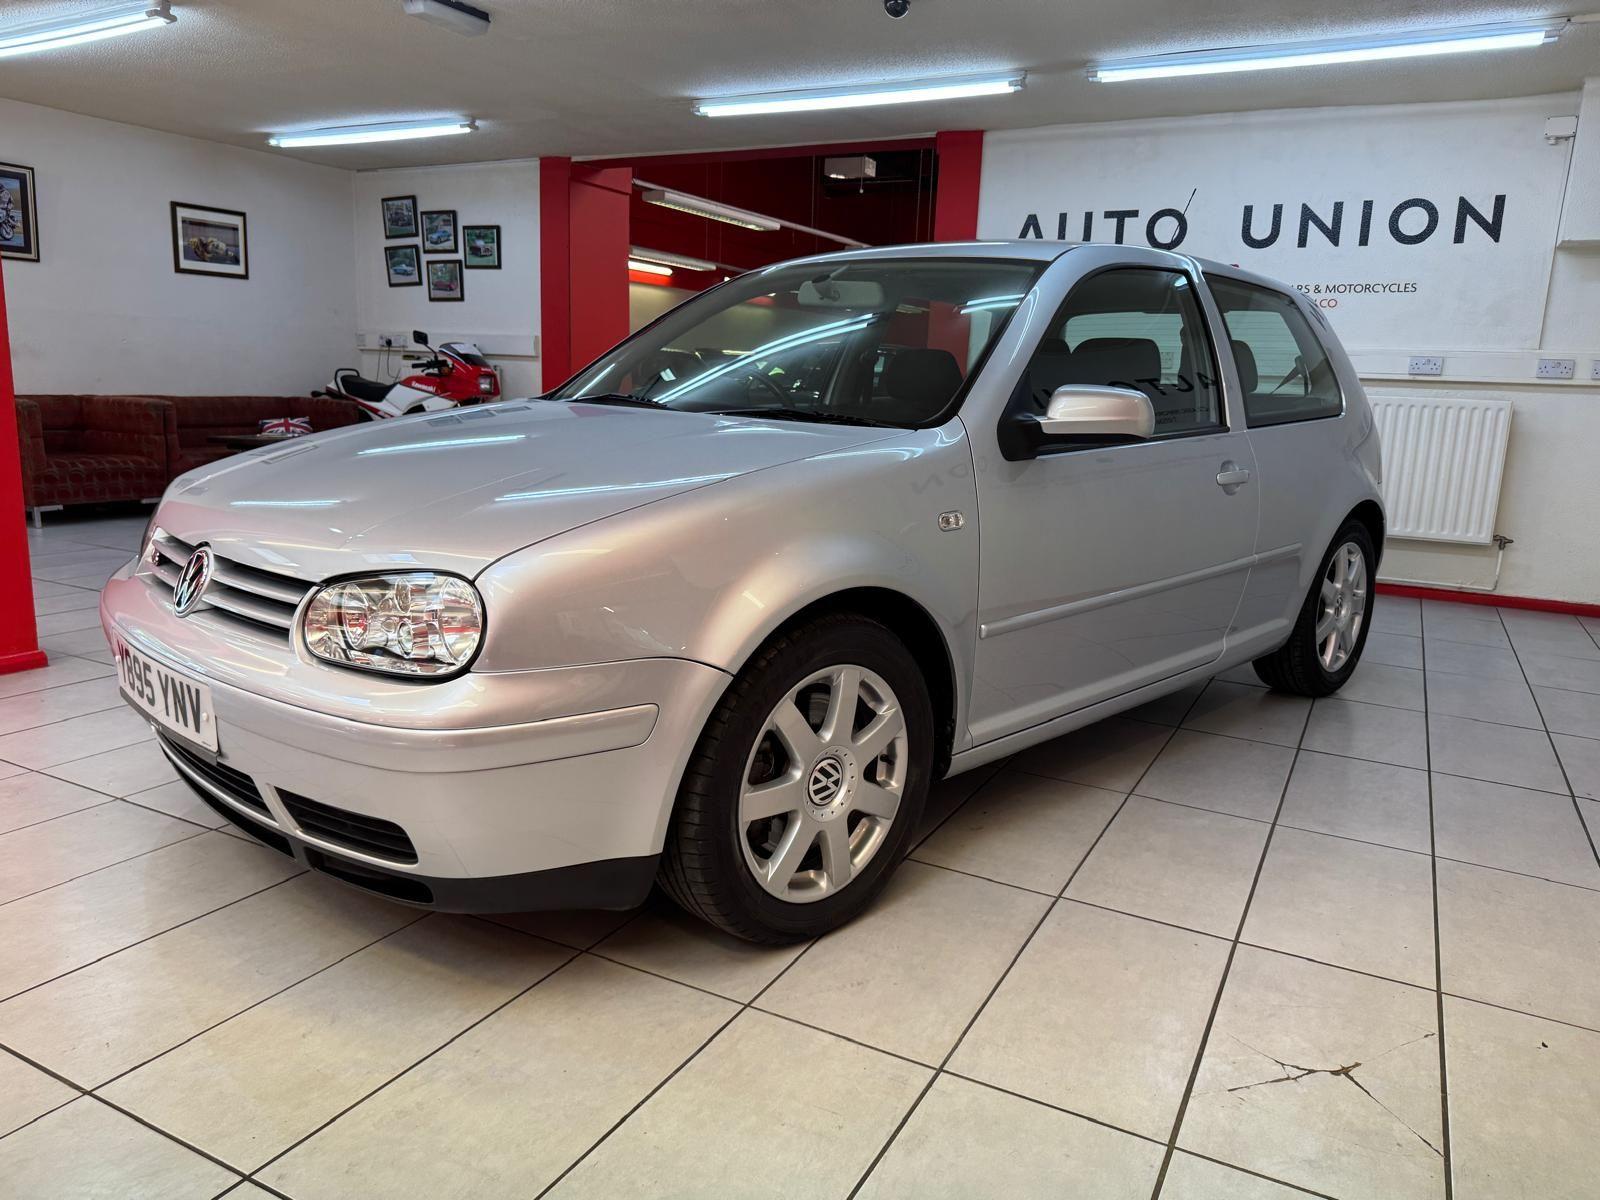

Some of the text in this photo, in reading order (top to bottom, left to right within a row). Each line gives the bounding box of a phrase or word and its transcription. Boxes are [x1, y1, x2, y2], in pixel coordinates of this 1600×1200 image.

[1018, 194, 1507, 250] AUTO UNION
[1313, 284, 1322, 294] &
[1325, 282, 1418, 294] MOTORCYCLES
[157, 669, 201, 735] YNV
